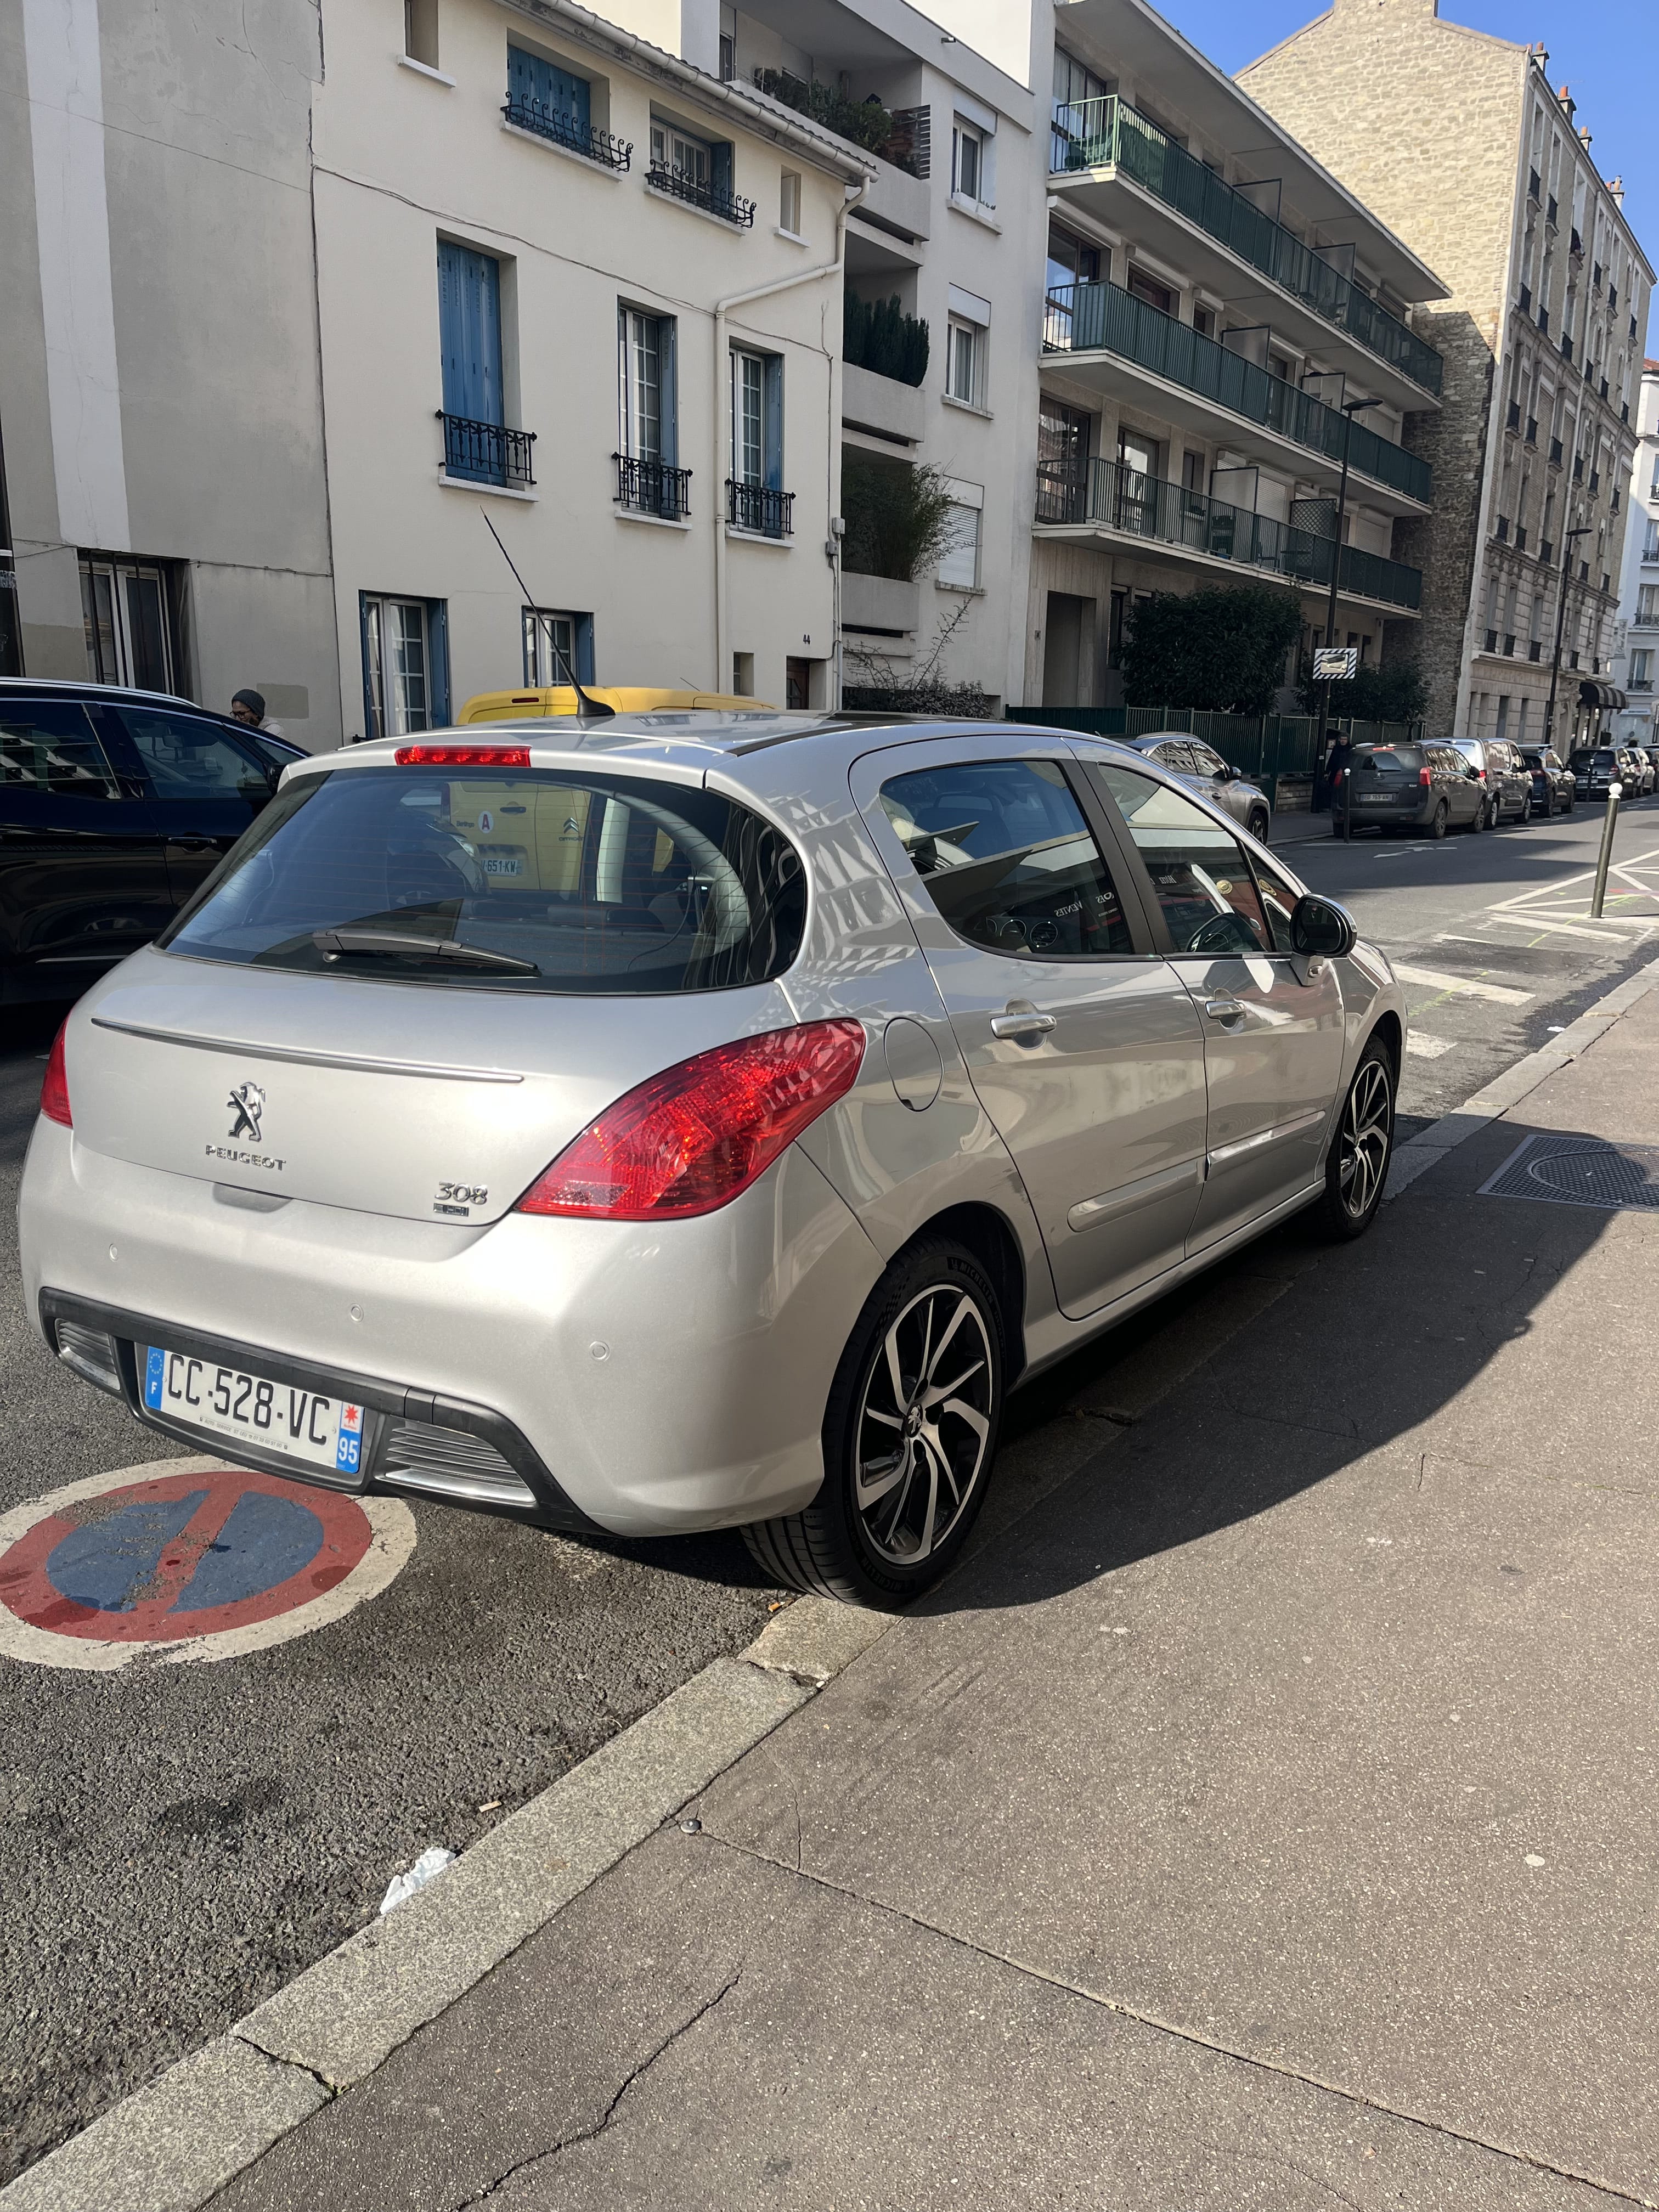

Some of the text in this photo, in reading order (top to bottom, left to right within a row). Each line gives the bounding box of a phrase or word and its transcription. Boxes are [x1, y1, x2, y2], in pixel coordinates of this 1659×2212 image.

[803, 634, 810, 645] 44
[482, 814, 490, 830] A
[205, 1144, 286, 1171] PEUGEOT
[434, 1181, 488, 1206] 308
[151, 1381, 157, 1395] F
[338, 1437, 358, 1464] 95
